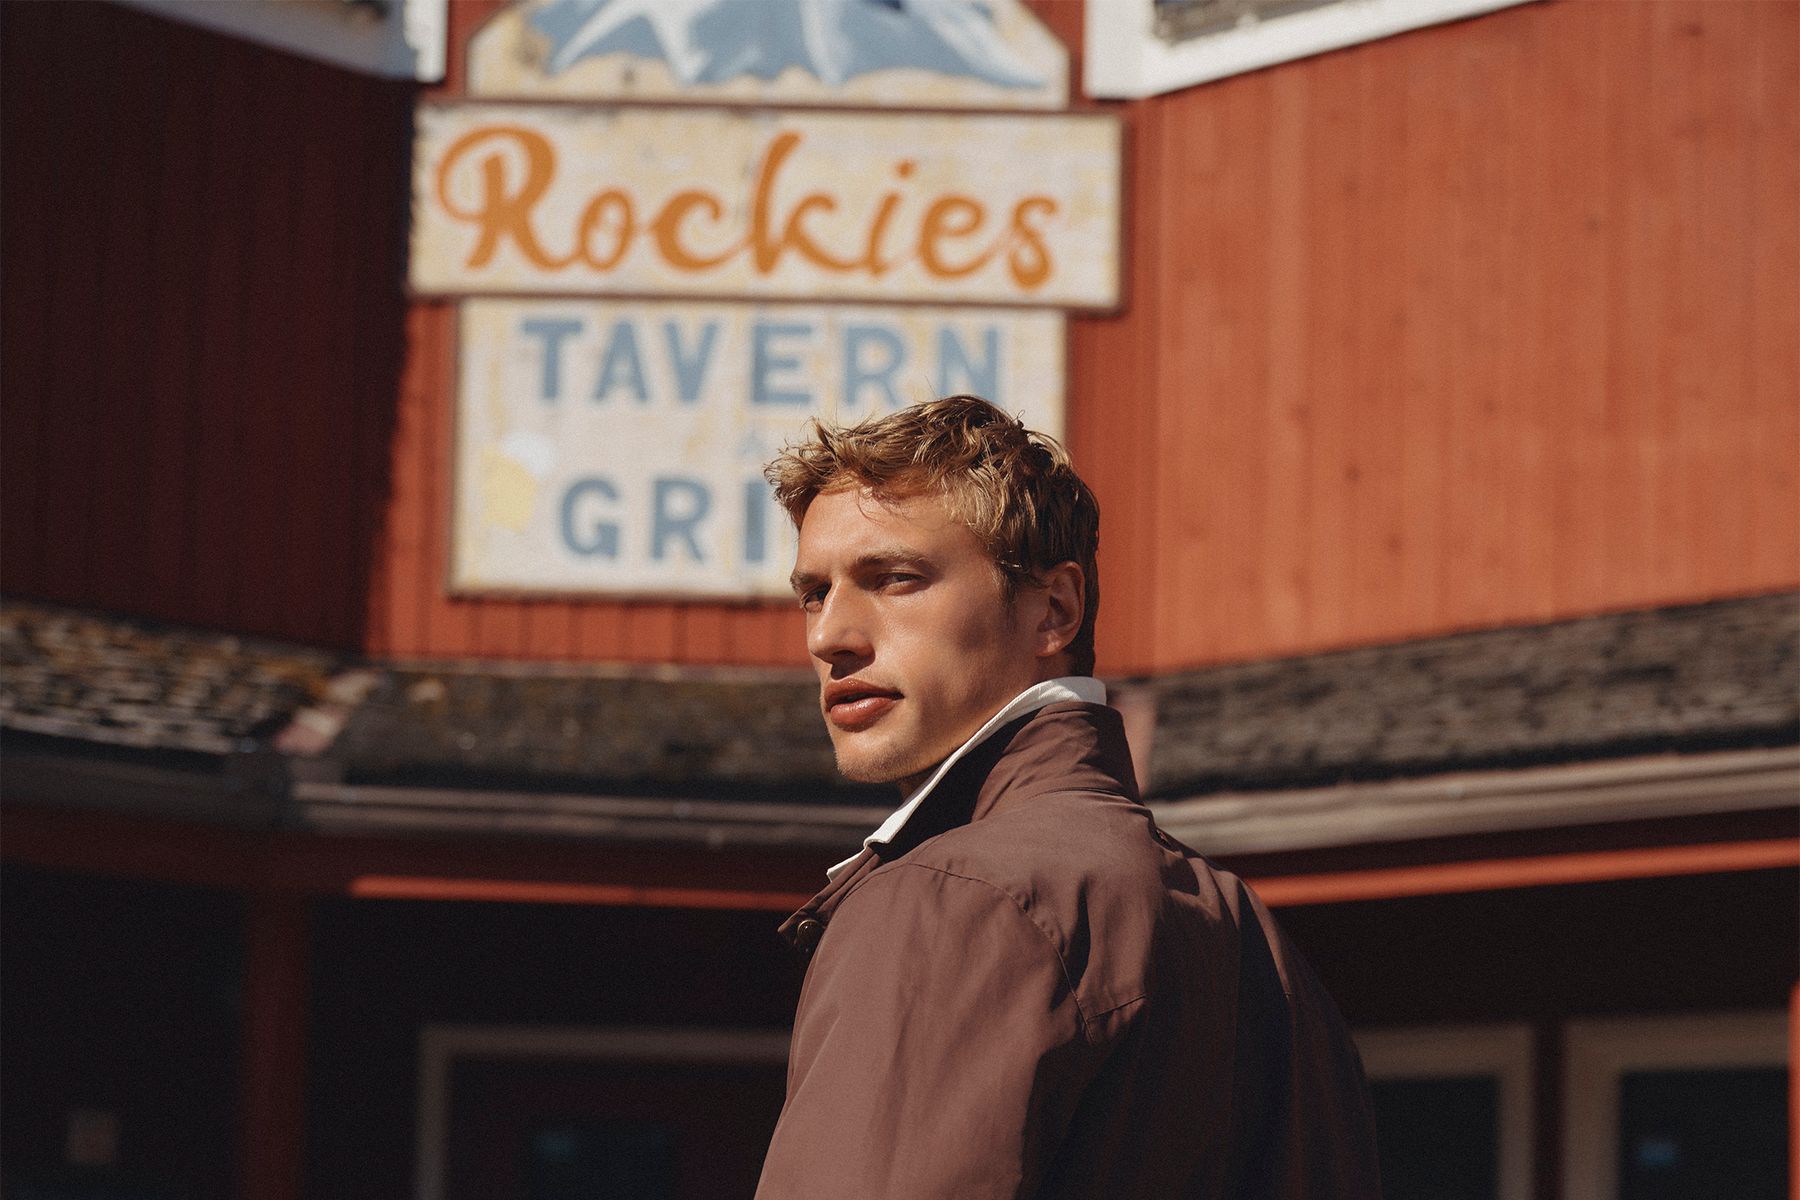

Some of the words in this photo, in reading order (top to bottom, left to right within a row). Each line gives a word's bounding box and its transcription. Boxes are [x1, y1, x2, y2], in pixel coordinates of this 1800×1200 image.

[433, 123, 1060, 293] Rockies
[520, 316, 1004, 409] TAVERN
[555, 474, 770, 564] GRI
